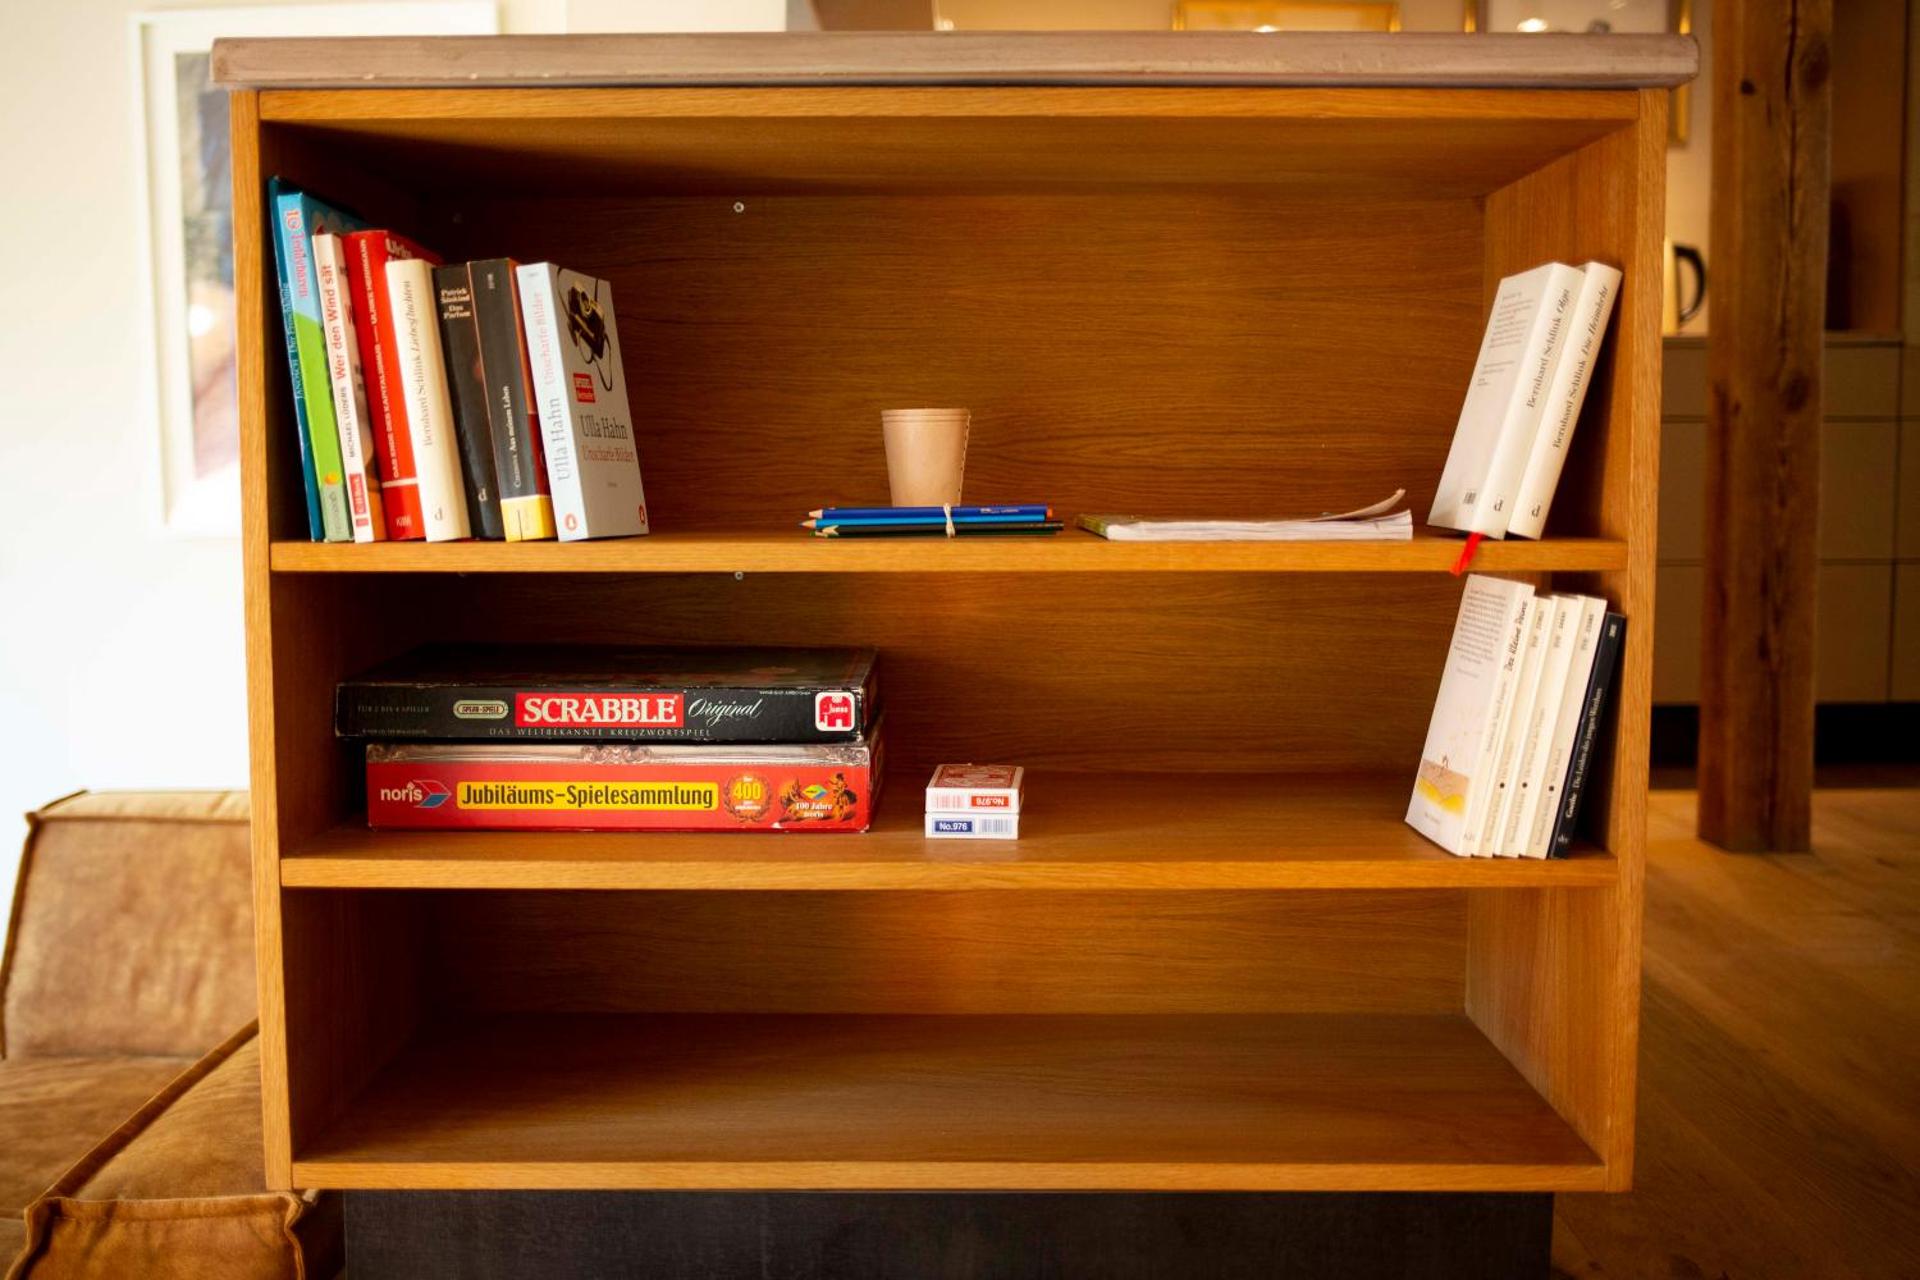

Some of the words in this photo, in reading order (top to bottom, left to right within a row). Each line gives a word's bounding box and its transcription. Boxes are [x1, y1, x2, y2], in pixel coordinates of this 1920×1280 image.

[321, 264, 334, 285] sät
[327, 289, 338, 322] Wind
[331, 326, 342, 350] den
[334, 354, 347, 380] Wer
[1526, 358, 1549, 408] Bernhard
[1544, 316, 1562, 356] Schlink
[375, 344, 389, 412] KAPITALISMUS
[413, 355, 426, 396] Schlink
[502, 386, 511, 408] Leben
[1552, 400, 1575, 448] Bernhard
[1568, 360, 1586, 396] Schlink
[1581, 336, 1593, 355] Die
[417, 397, 433, 445] Bernhard
[548, 398, 564, 441] Hahn
[580, 414, 602, 437] Ulla
[601, 417, 628, 440] Hahn
[345, 421, 356, 458] MICHAEL
[509, 437, 517, 452] Aus
[554, 446, 570, 481] Ulla
[524, 697, 677, 723] SCRABBLE
[688, 698, 763, 727] Original
[489, 728, 511, 736] DAS
[517, 728, 602, 736] WELTBEKANNTE
[610, 729, 711, 737] KREUZWORTSPIEL
[381, 784, 423, 803] noris
[462, 784, 714, 809] Jubiläums-Spielesammlung
[732, 782, 760, 800] 400
[795, 803, 809, 811] 100
[939, 822, 968, 831] No.976
